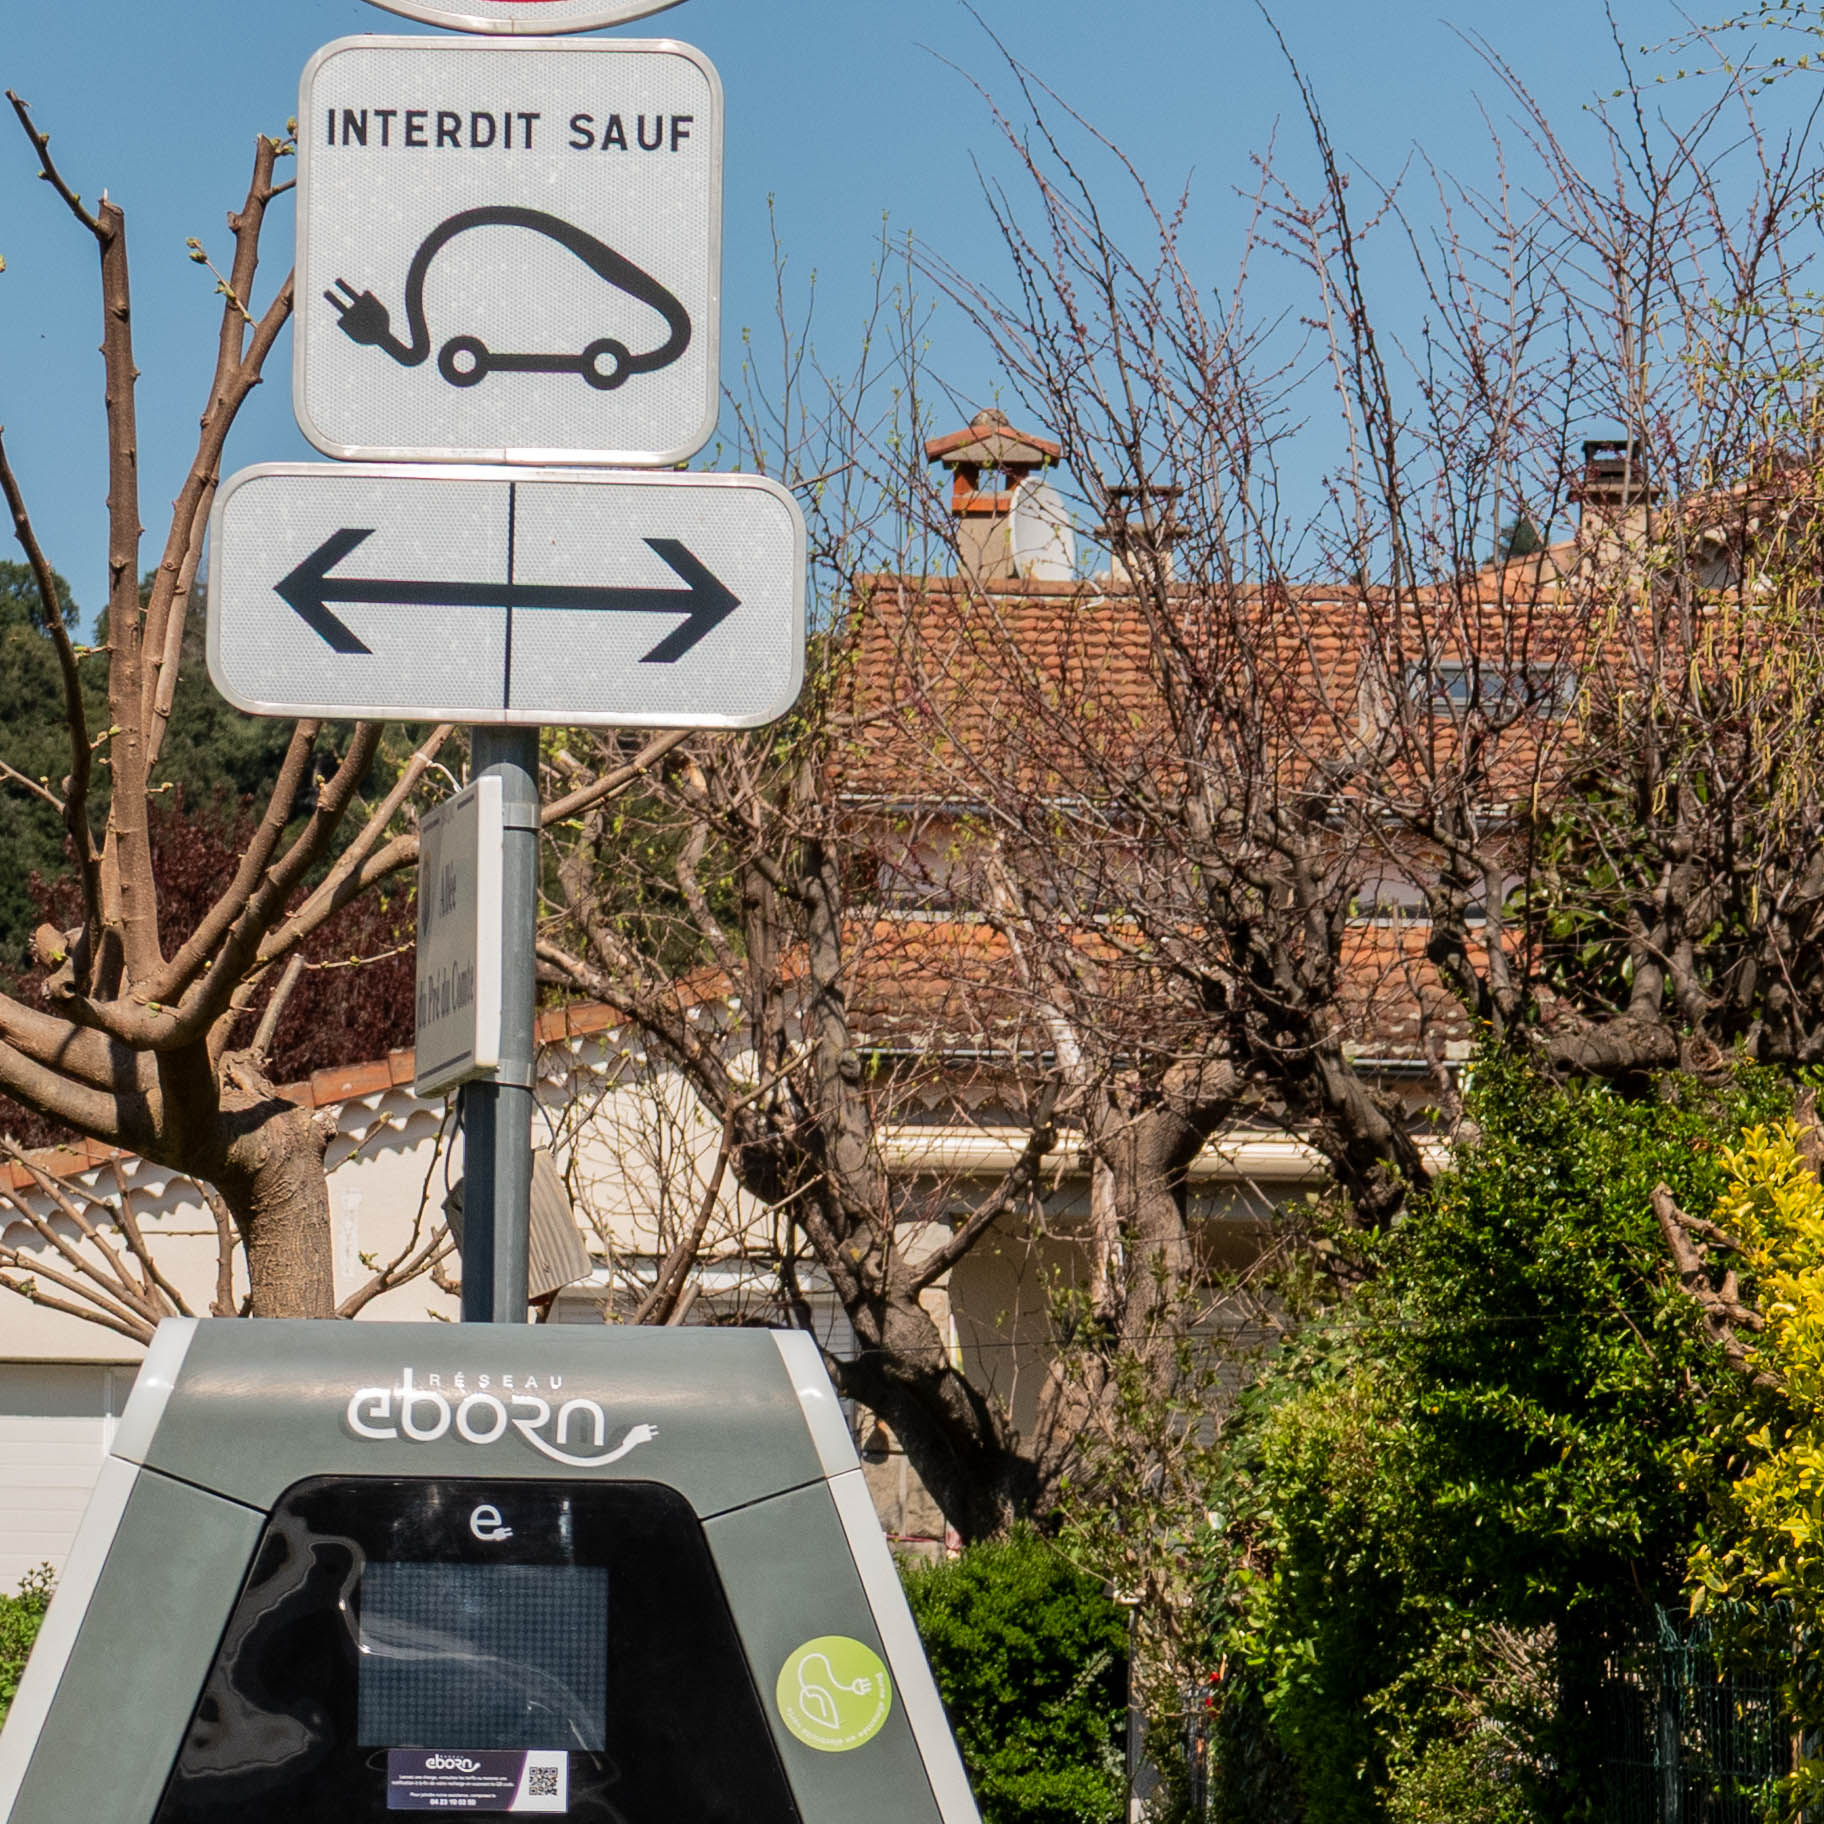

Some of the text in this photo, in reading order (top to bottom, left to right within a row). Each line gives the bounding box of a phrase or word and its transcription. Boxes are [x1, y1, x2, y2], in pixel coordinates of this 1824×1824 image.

[327, 109, 695, 152] INTERDIT SAUF
[430, 1371, 563, 1389] RÉSEAU
[347, 1367, 659, 1467] eborn
[425, 1753, 481, 1773] eborn
